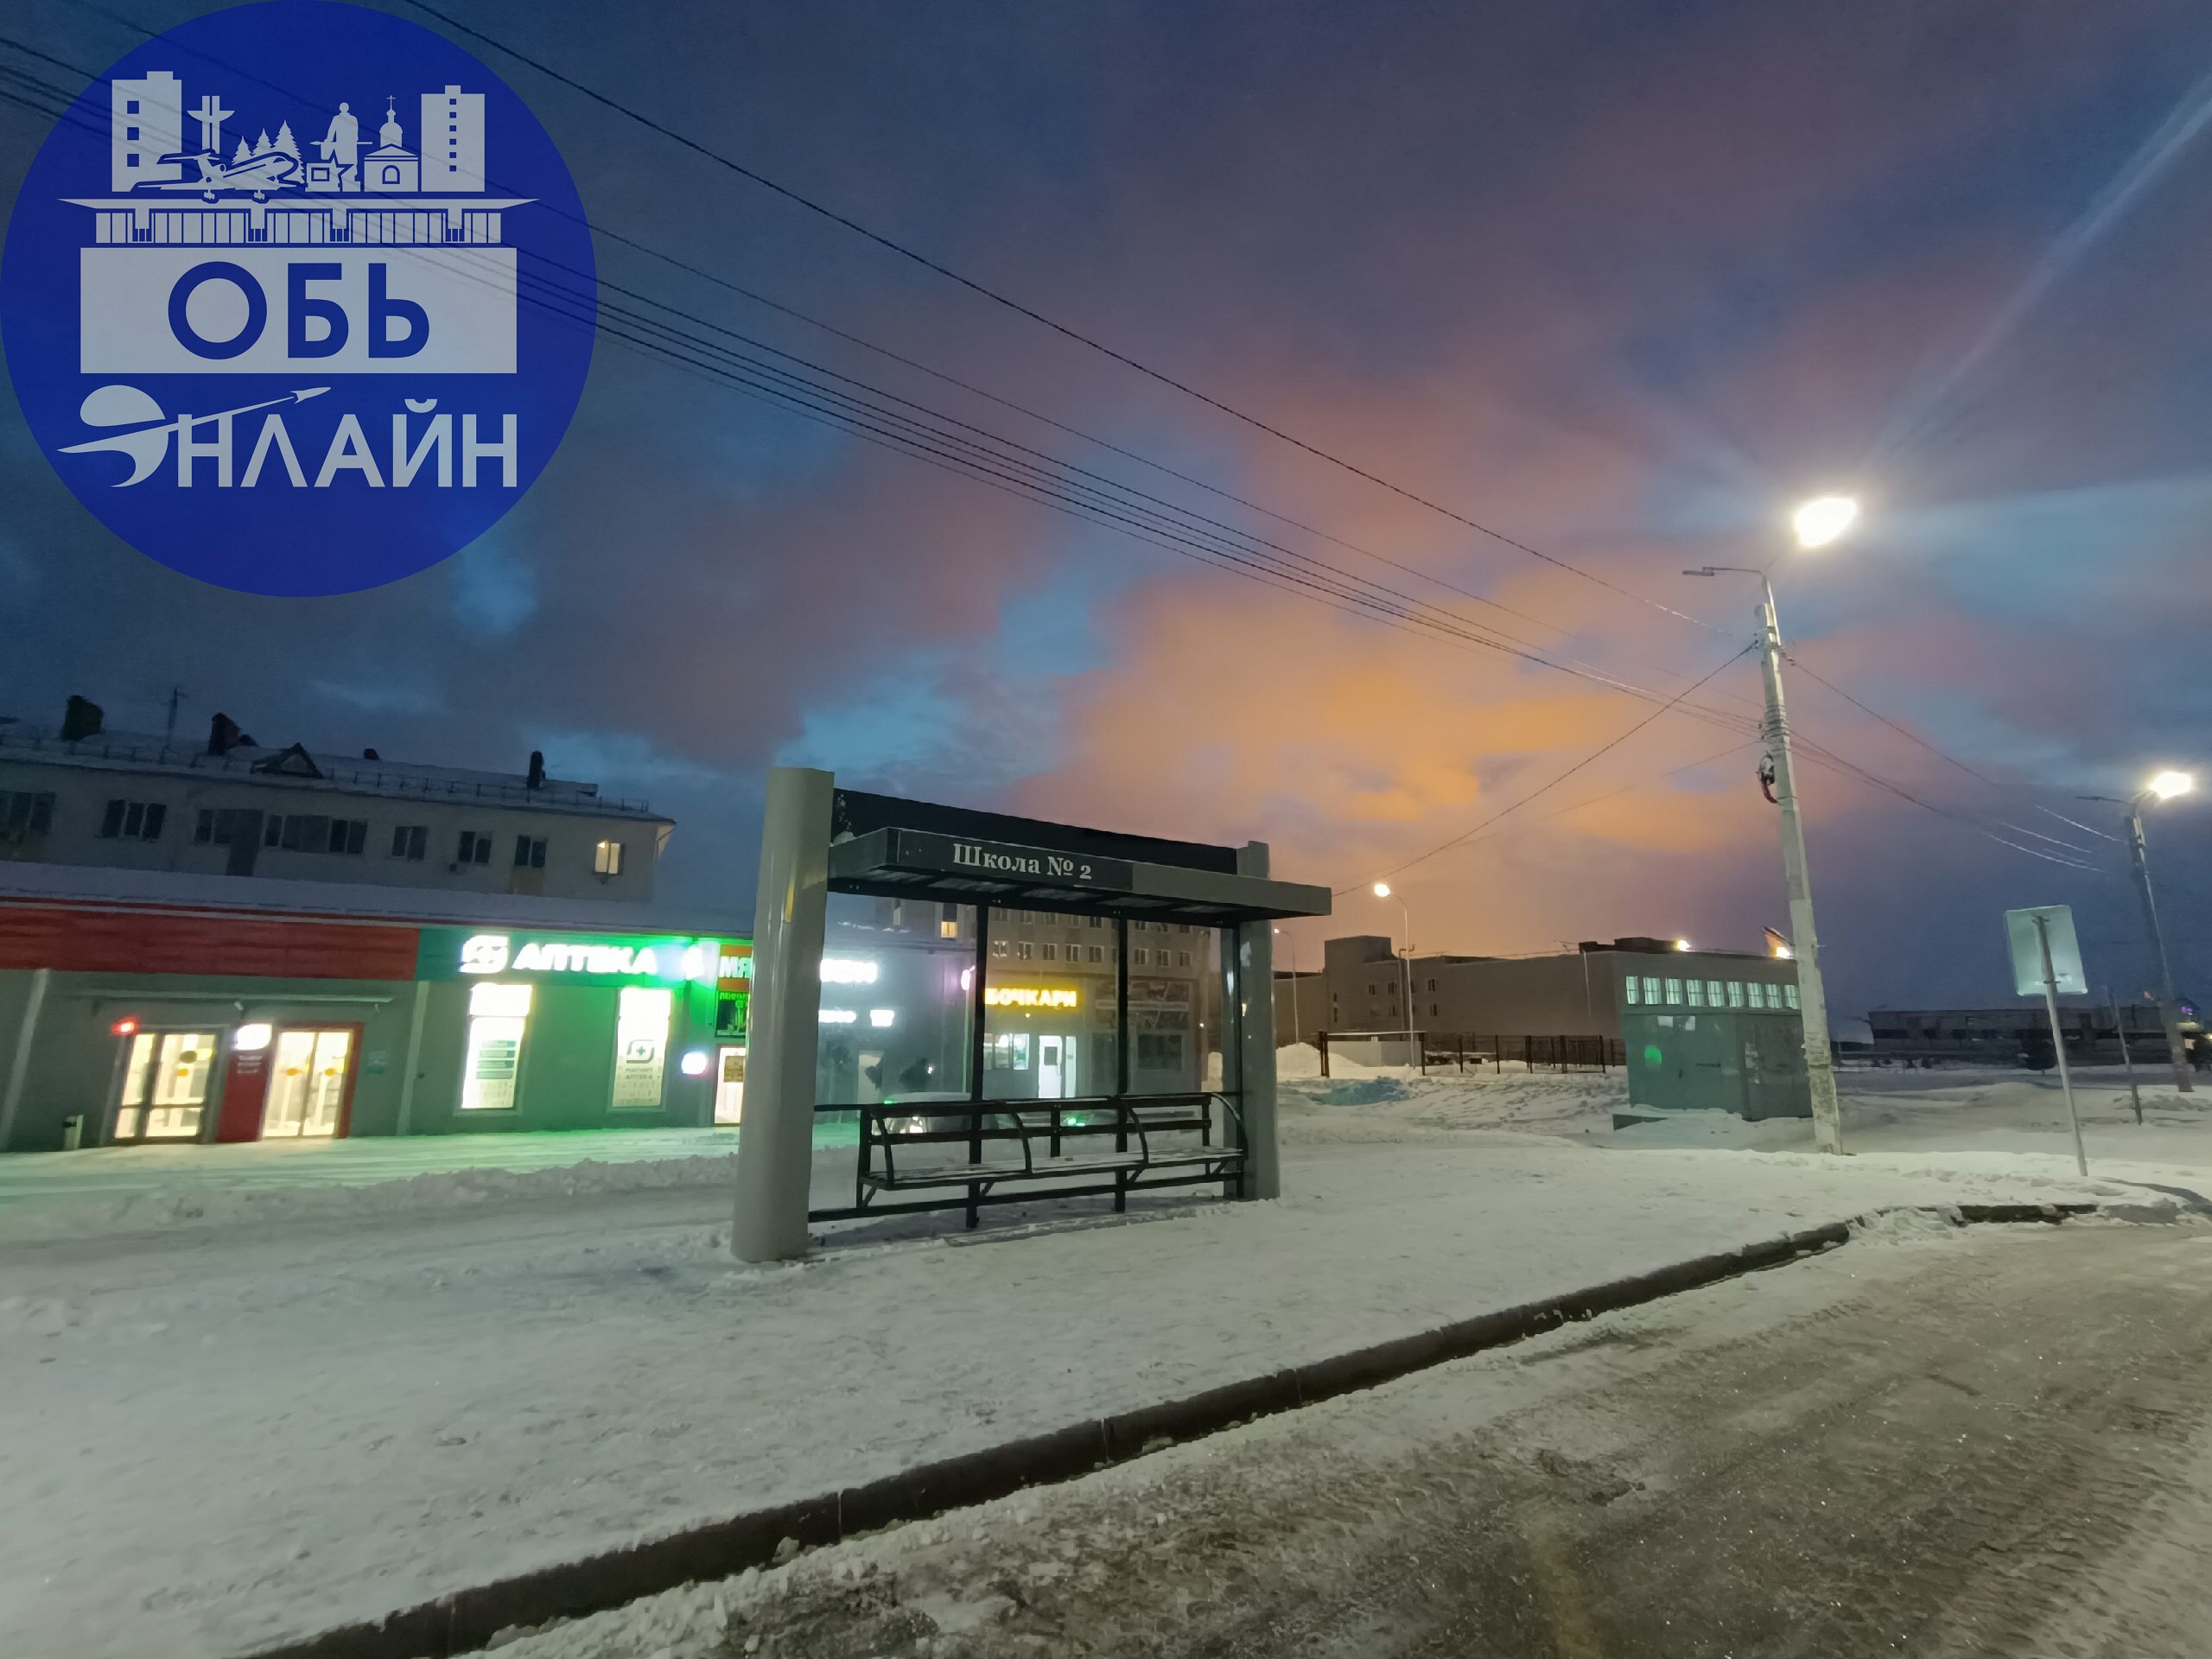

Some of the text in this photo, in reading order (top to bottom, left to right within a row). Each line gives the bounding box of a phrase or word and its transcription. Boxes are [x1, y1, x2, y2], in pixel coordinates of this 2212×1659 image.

[953, 843, 1092, 880] Школа № 2
[512, 943, 658, 974] АПТЕКА
